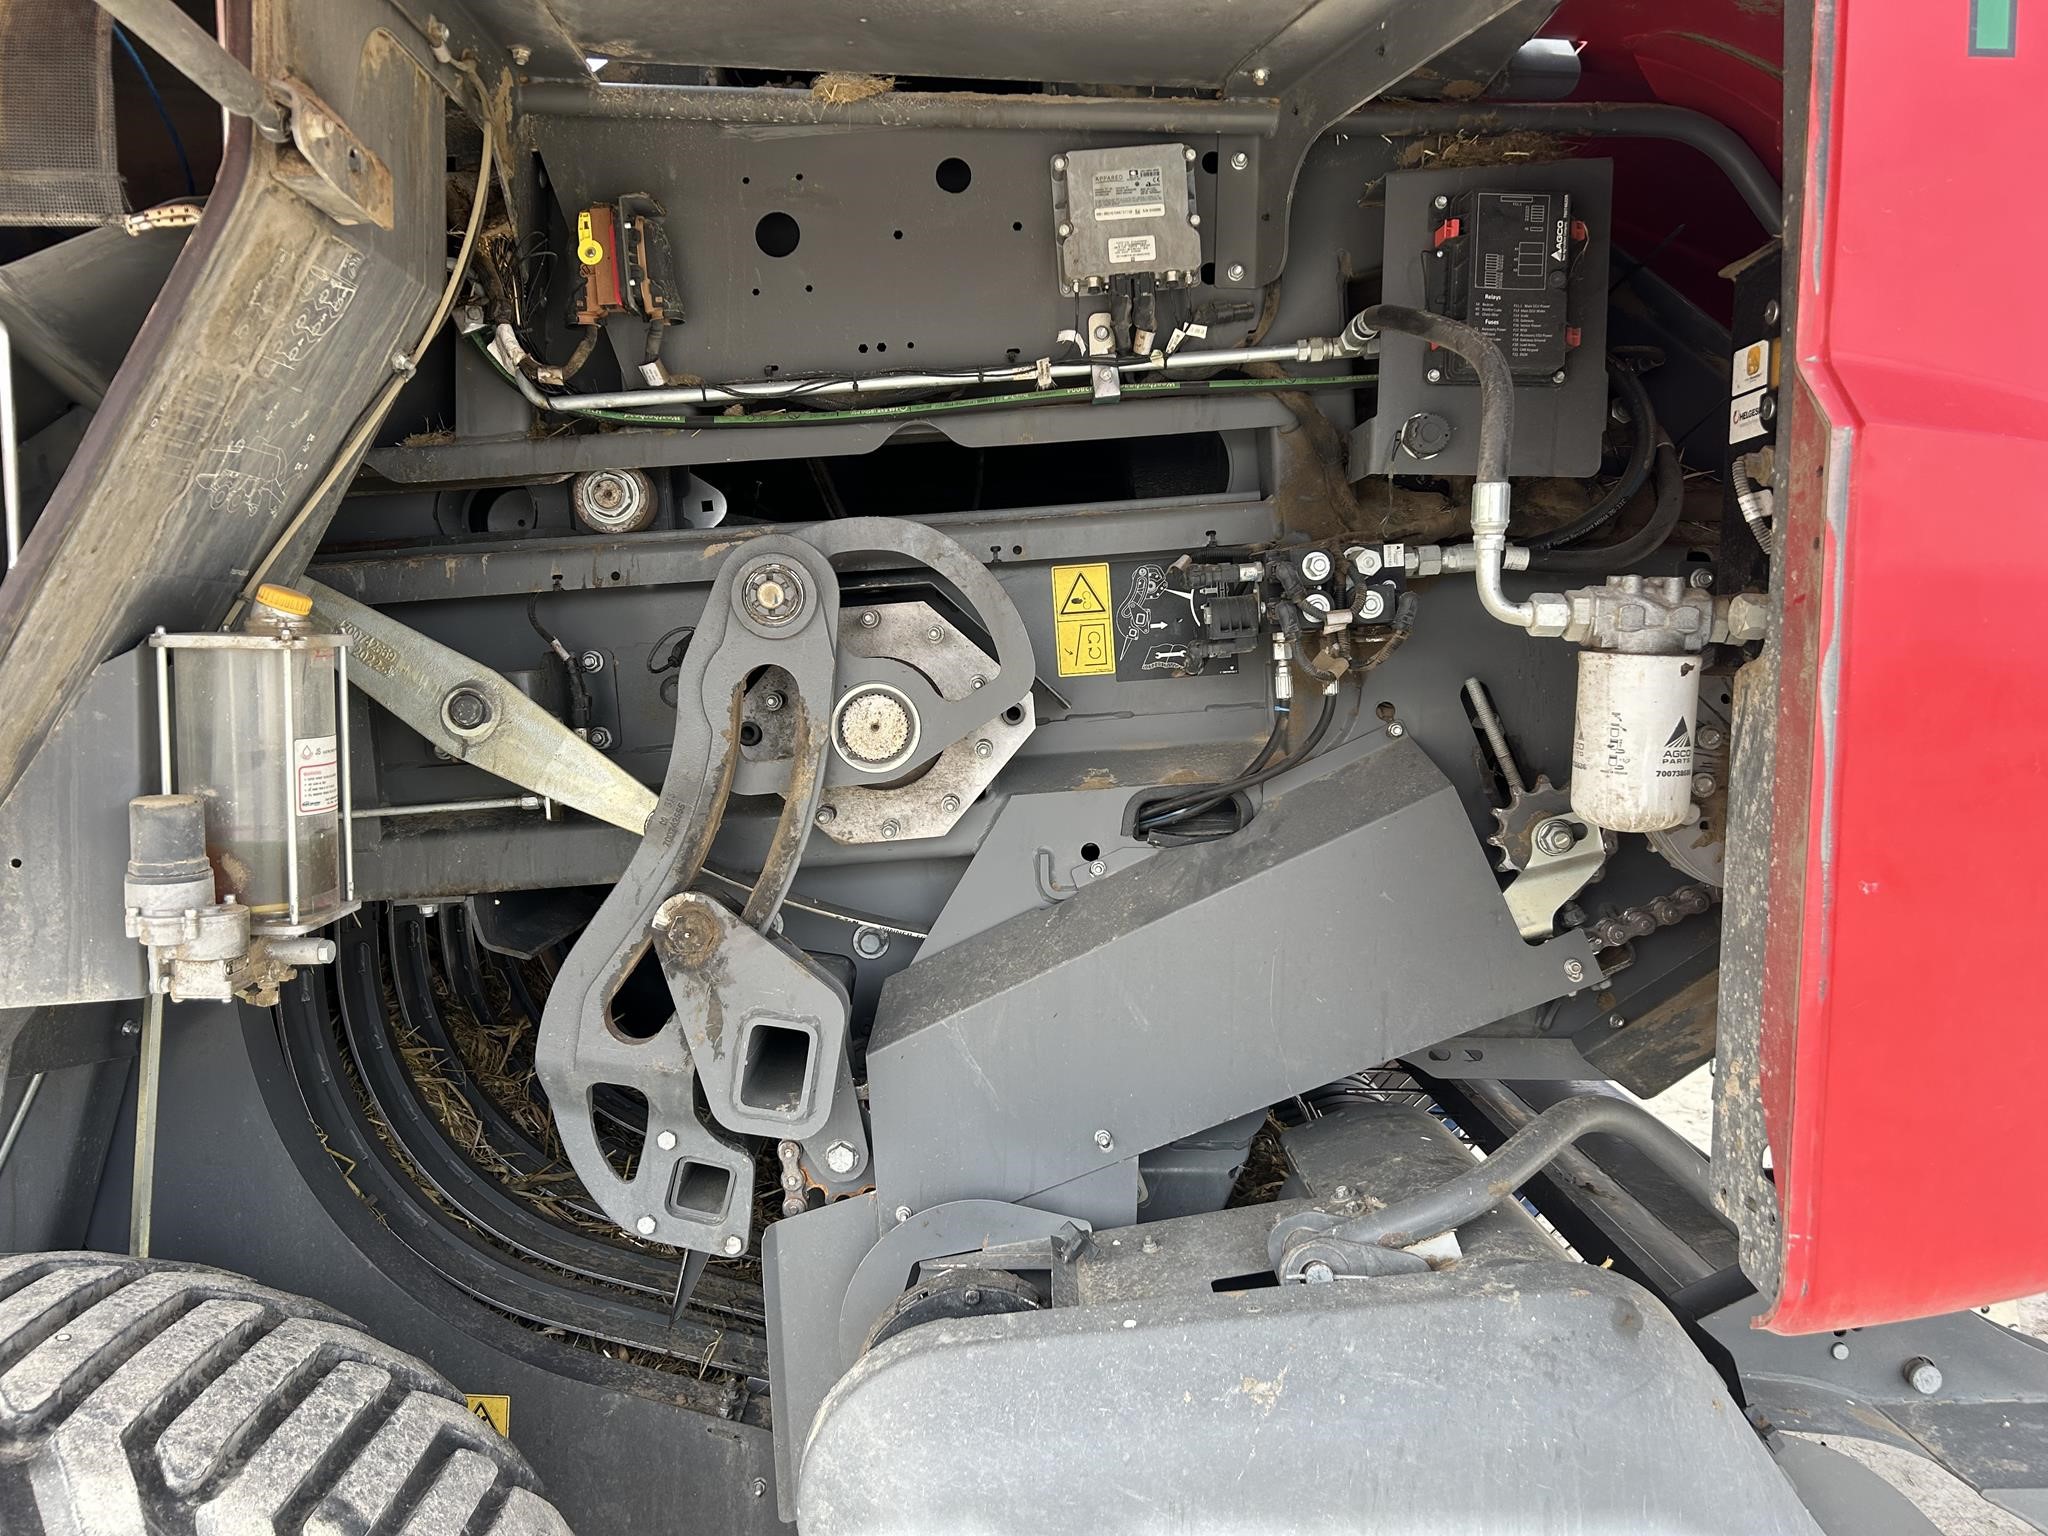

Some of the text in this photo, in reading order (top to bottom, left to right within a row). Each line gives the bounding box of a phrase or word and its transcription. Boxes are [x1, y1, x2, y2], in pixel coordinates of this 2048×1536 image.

[1556, 220, 1564, 249] AGCO
[1485, 293, 1501, 301] Relays
[1739, 407, 1762, 422] HELGES
[1663, 750, 1691, 758] AGCO
